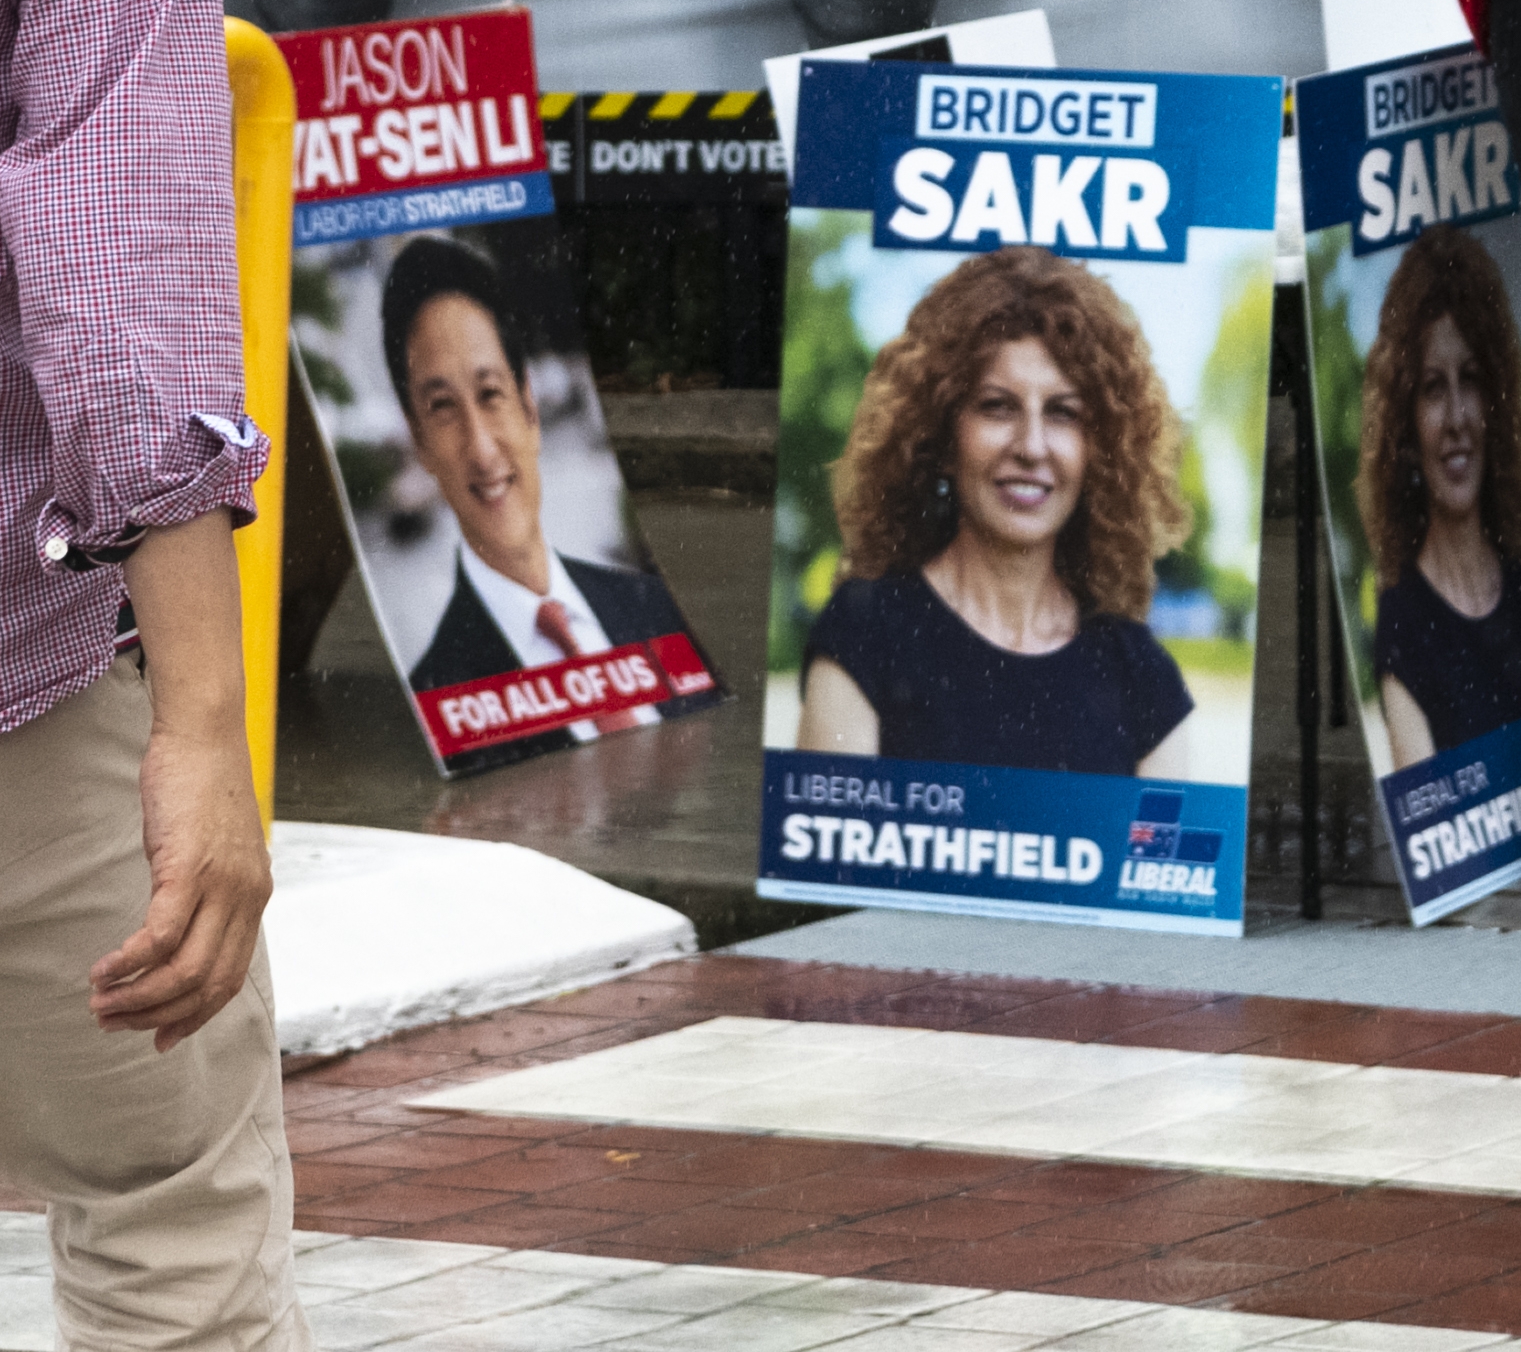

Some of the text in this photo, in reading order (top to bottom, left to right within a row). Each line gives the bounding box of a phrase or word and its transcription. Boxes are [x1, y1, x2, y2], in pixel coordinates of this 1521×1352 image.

[321, 24, 469, 112] JASON
[481, 94, 534, 165] LI
[929, 83, 1146, 141] BRIDGET
[590, 138, 694, 175] DON'T
[1358, 120, 1512, 242] SAKR
[299, 180, 527, 240] LABOR FOR STRATHFIELD
[888, 147, 1172, 253] SAKR
[437, 653, 659, 737] FOR ALL OF US
[784, 772, 965, 815] LIBERAL FOR
[781, 813, 1103, 885] STRATHFIELD
[1117, 860, 1218, 897] LIBERAL
